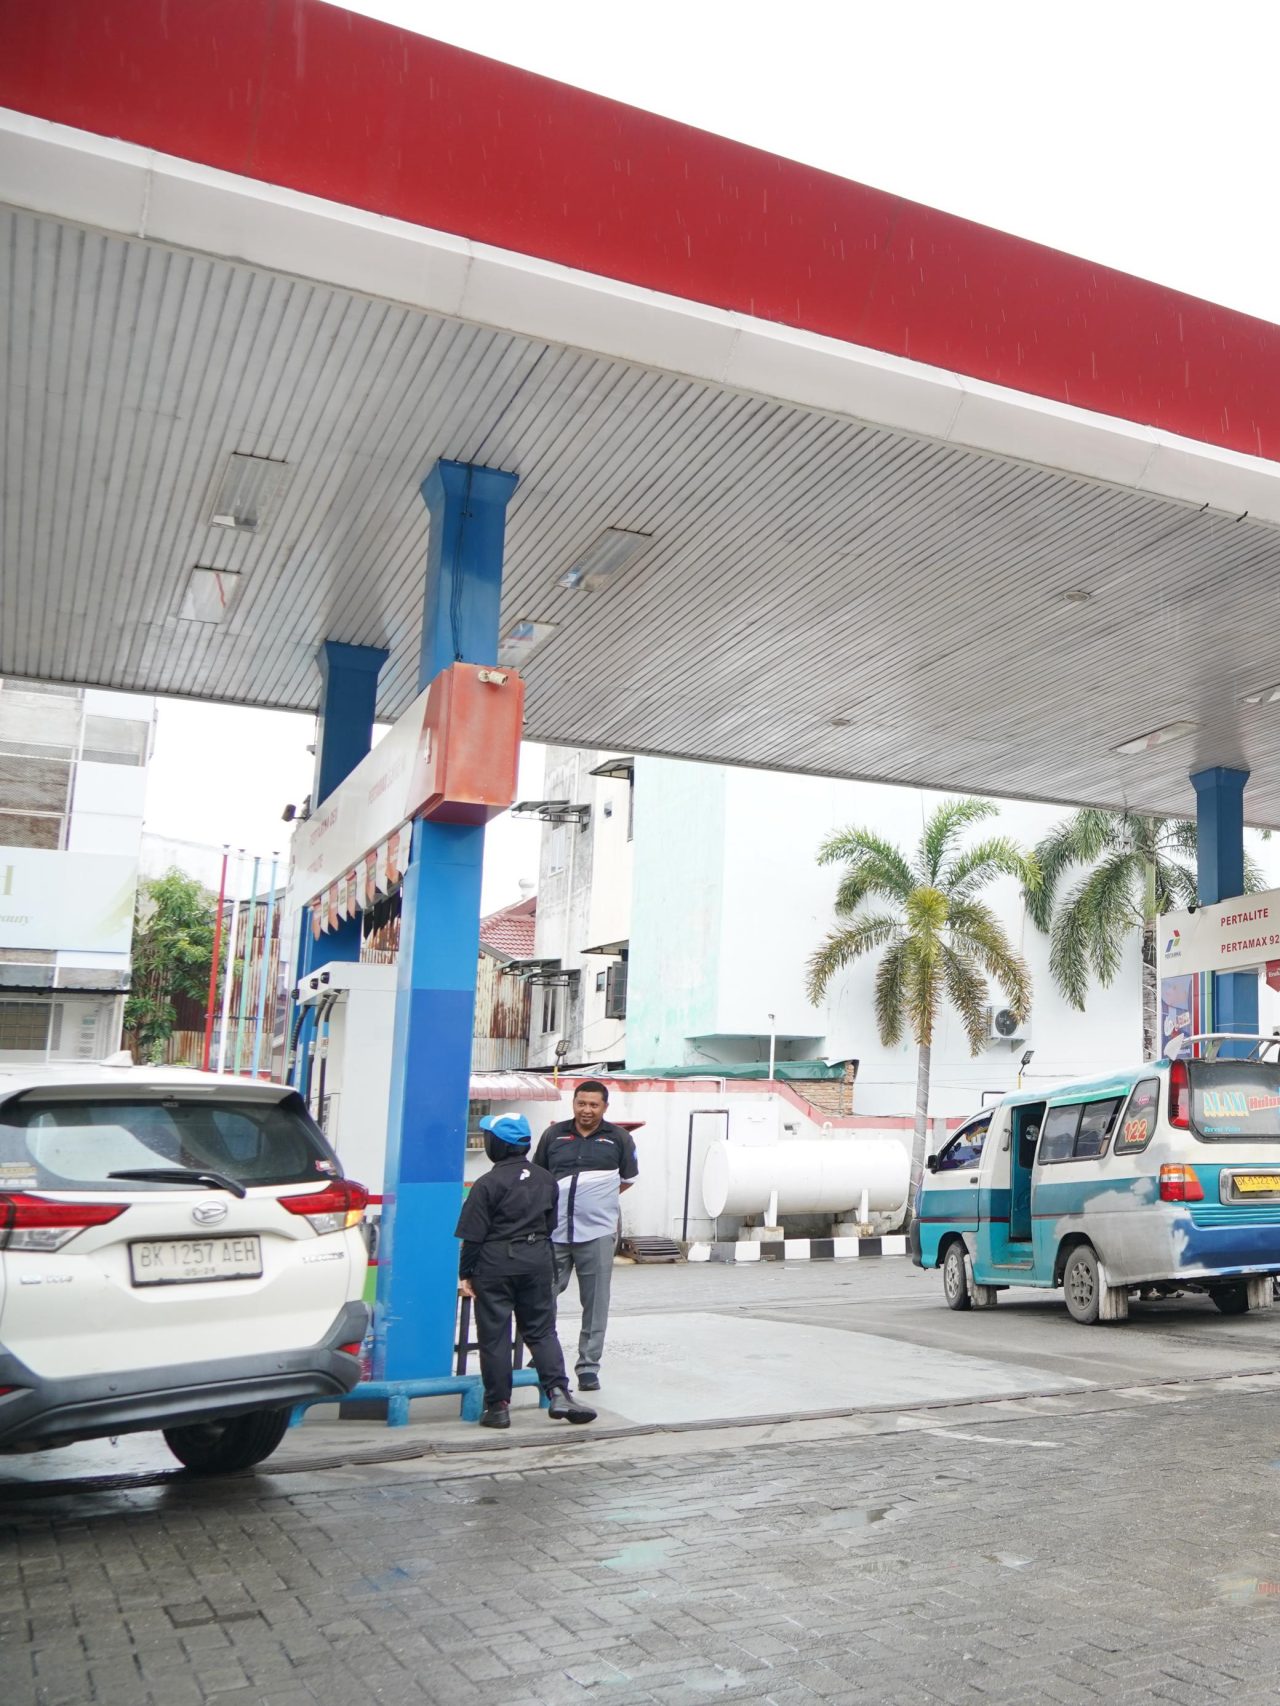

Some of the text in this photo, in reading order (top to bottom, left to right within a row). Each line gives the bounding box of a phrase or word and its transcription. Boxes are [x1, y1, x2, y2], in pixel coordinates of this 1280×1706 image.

[1220, 908, 1269, 927] PERTALITE
[1221, 934, 1280, 953] PERTAMAX 92
[1124, 1119, 1148, 1143] 122
[141, 1240, 257, 1267] BK 1257 AEH
